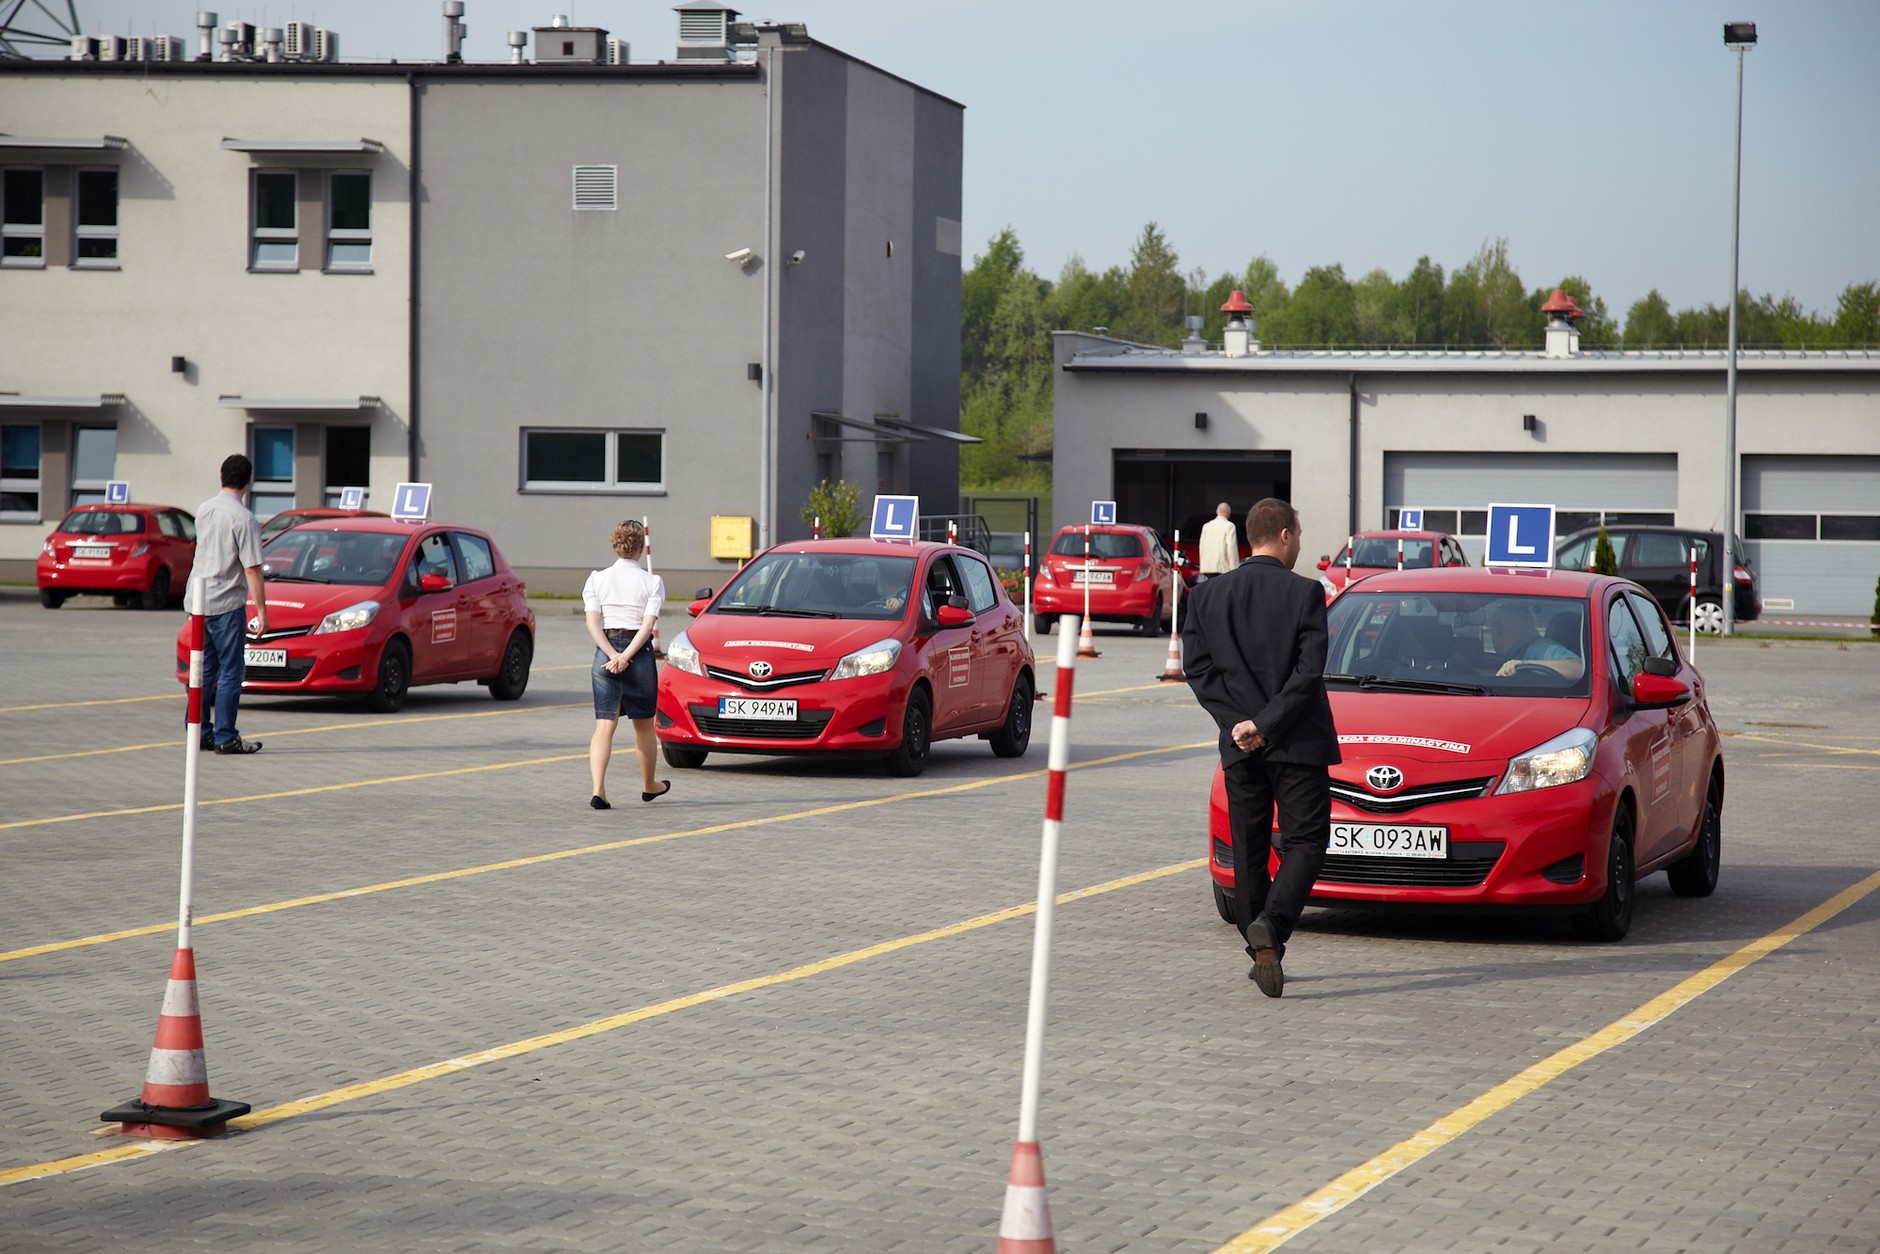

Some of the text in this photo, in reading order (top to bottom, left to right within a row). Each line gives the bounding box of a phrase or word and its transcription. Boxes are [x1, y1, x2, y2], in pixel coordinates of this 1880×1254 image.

[111, 485, 123, 500] L
[346, 491, 356, 505] L
[403, 489, 419, 512] L
[885, 503, 903, 530] L
[1099, 505, 1110, 520] L
[1406, 512, 1417, 527] L
[1507, 514, 1536, 555] L
[249, 650, 284, 663] 920AW
[728, 700, 795, 715] SK 949AW
[1334, 827, 1442, 851] SK 093AW
